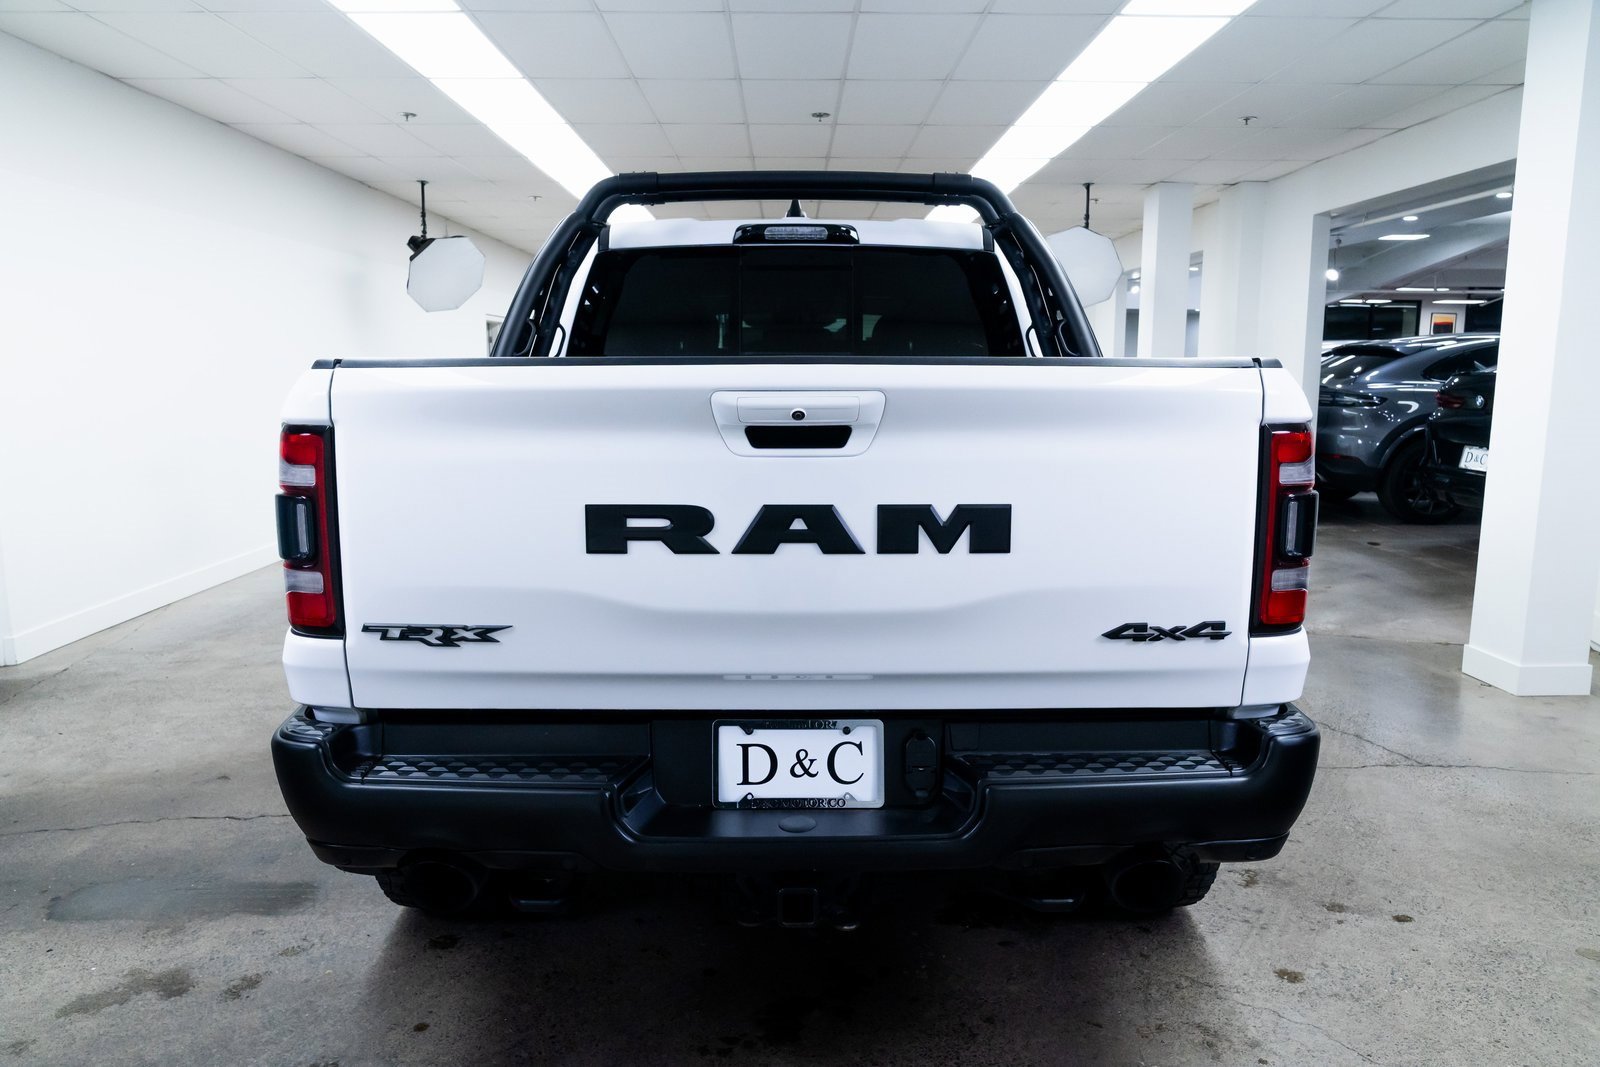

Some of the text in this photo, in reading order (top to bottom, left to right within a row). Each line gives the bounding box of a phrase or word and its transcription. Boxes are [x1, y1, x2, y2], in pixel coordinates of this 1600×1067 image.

[585, 504, 1012, 555] RAM
[361, 623, 513, 648] TRX
[828, 798, 846, 808] CO
